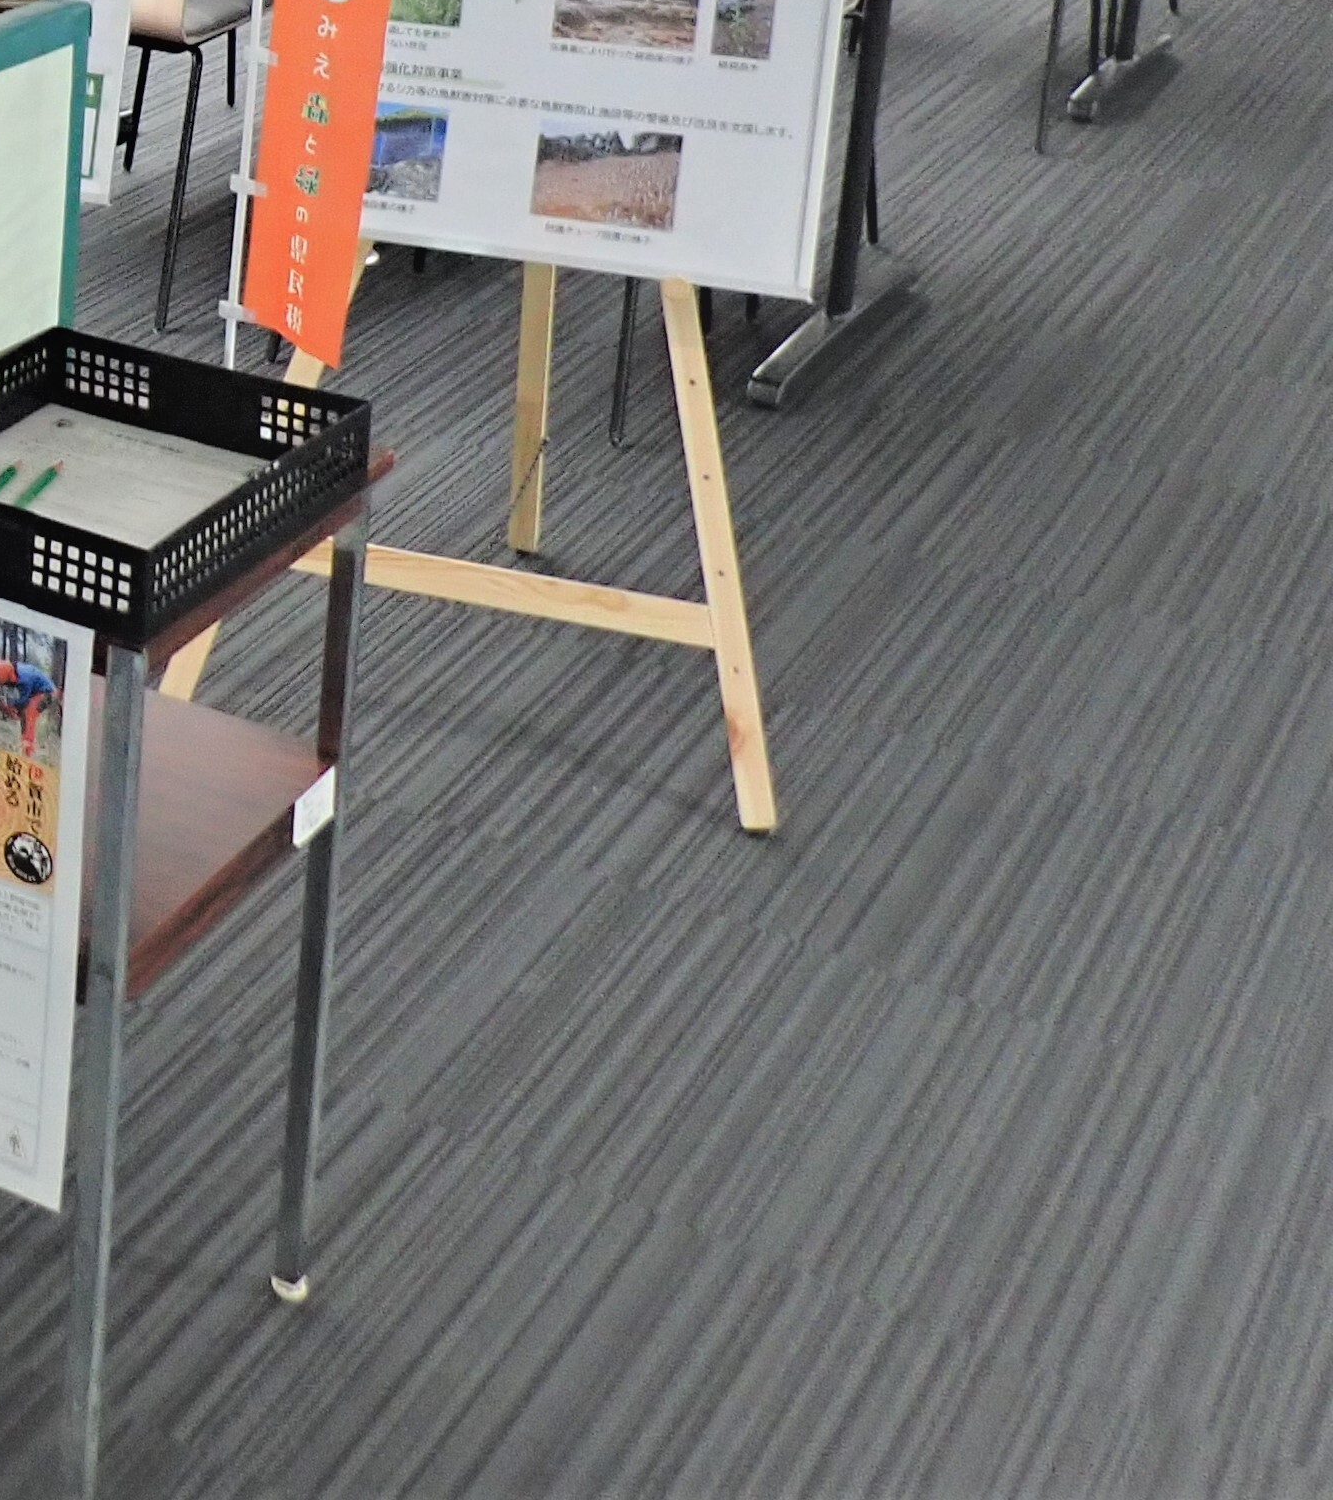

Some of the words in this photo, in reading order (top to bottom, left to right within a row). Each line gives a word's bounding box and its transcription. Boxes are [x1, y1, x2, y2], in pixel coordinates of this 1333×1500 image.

[286, 14, 339, 336] みえ森と緑の県民税
